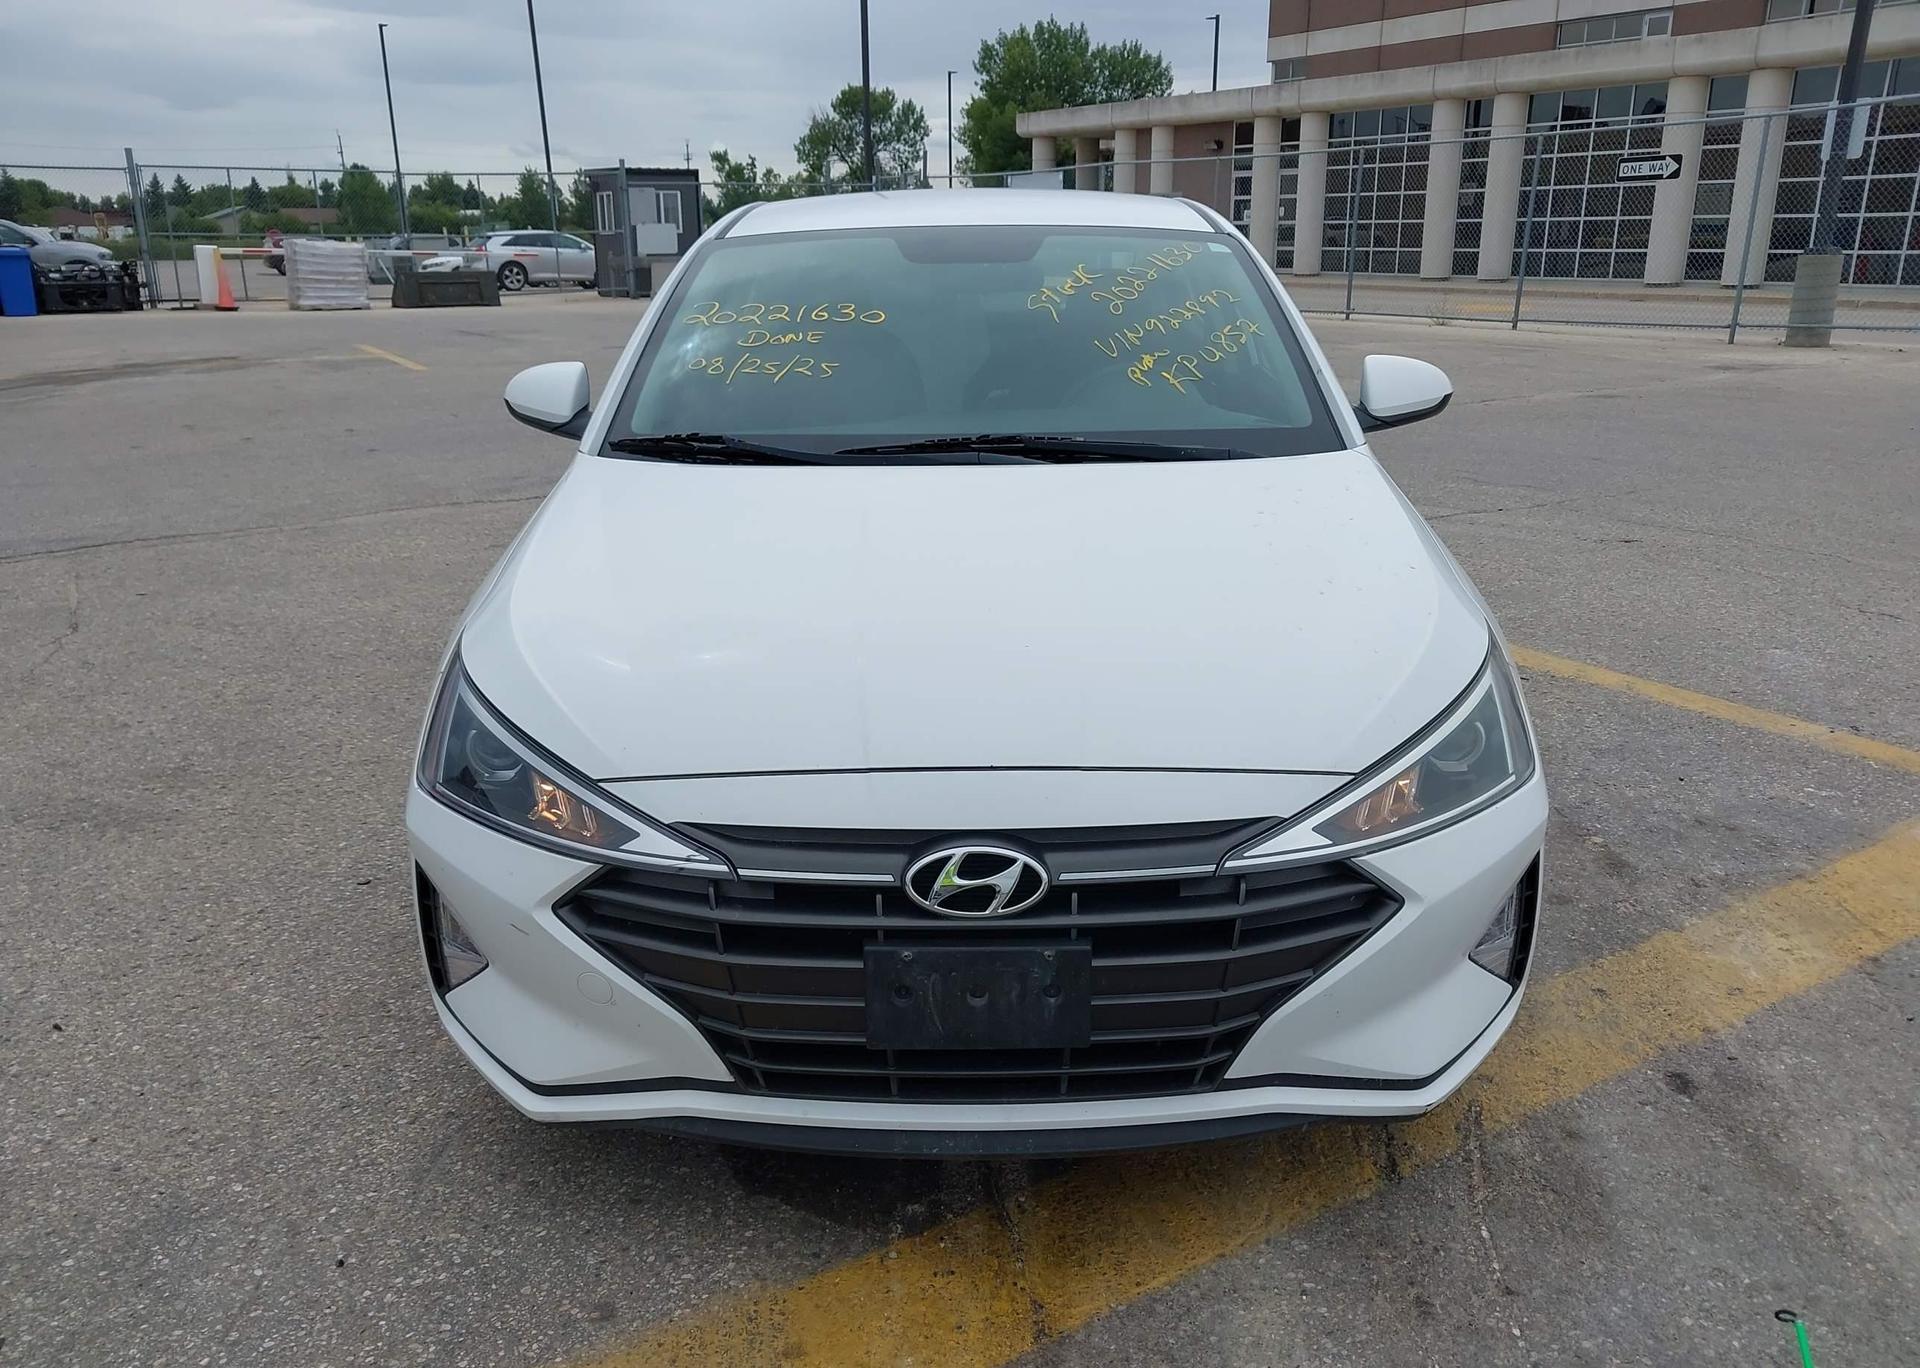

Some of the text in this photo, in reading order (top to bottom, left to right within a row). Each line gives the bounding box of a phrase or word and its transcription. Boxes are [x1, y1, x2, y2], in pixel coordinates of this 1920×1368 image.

[1622, 161, 1671, 175] ONE WAY
[683, 302, 887, 326] 20221630
[688, 352, 841, 384] 08/25/25
